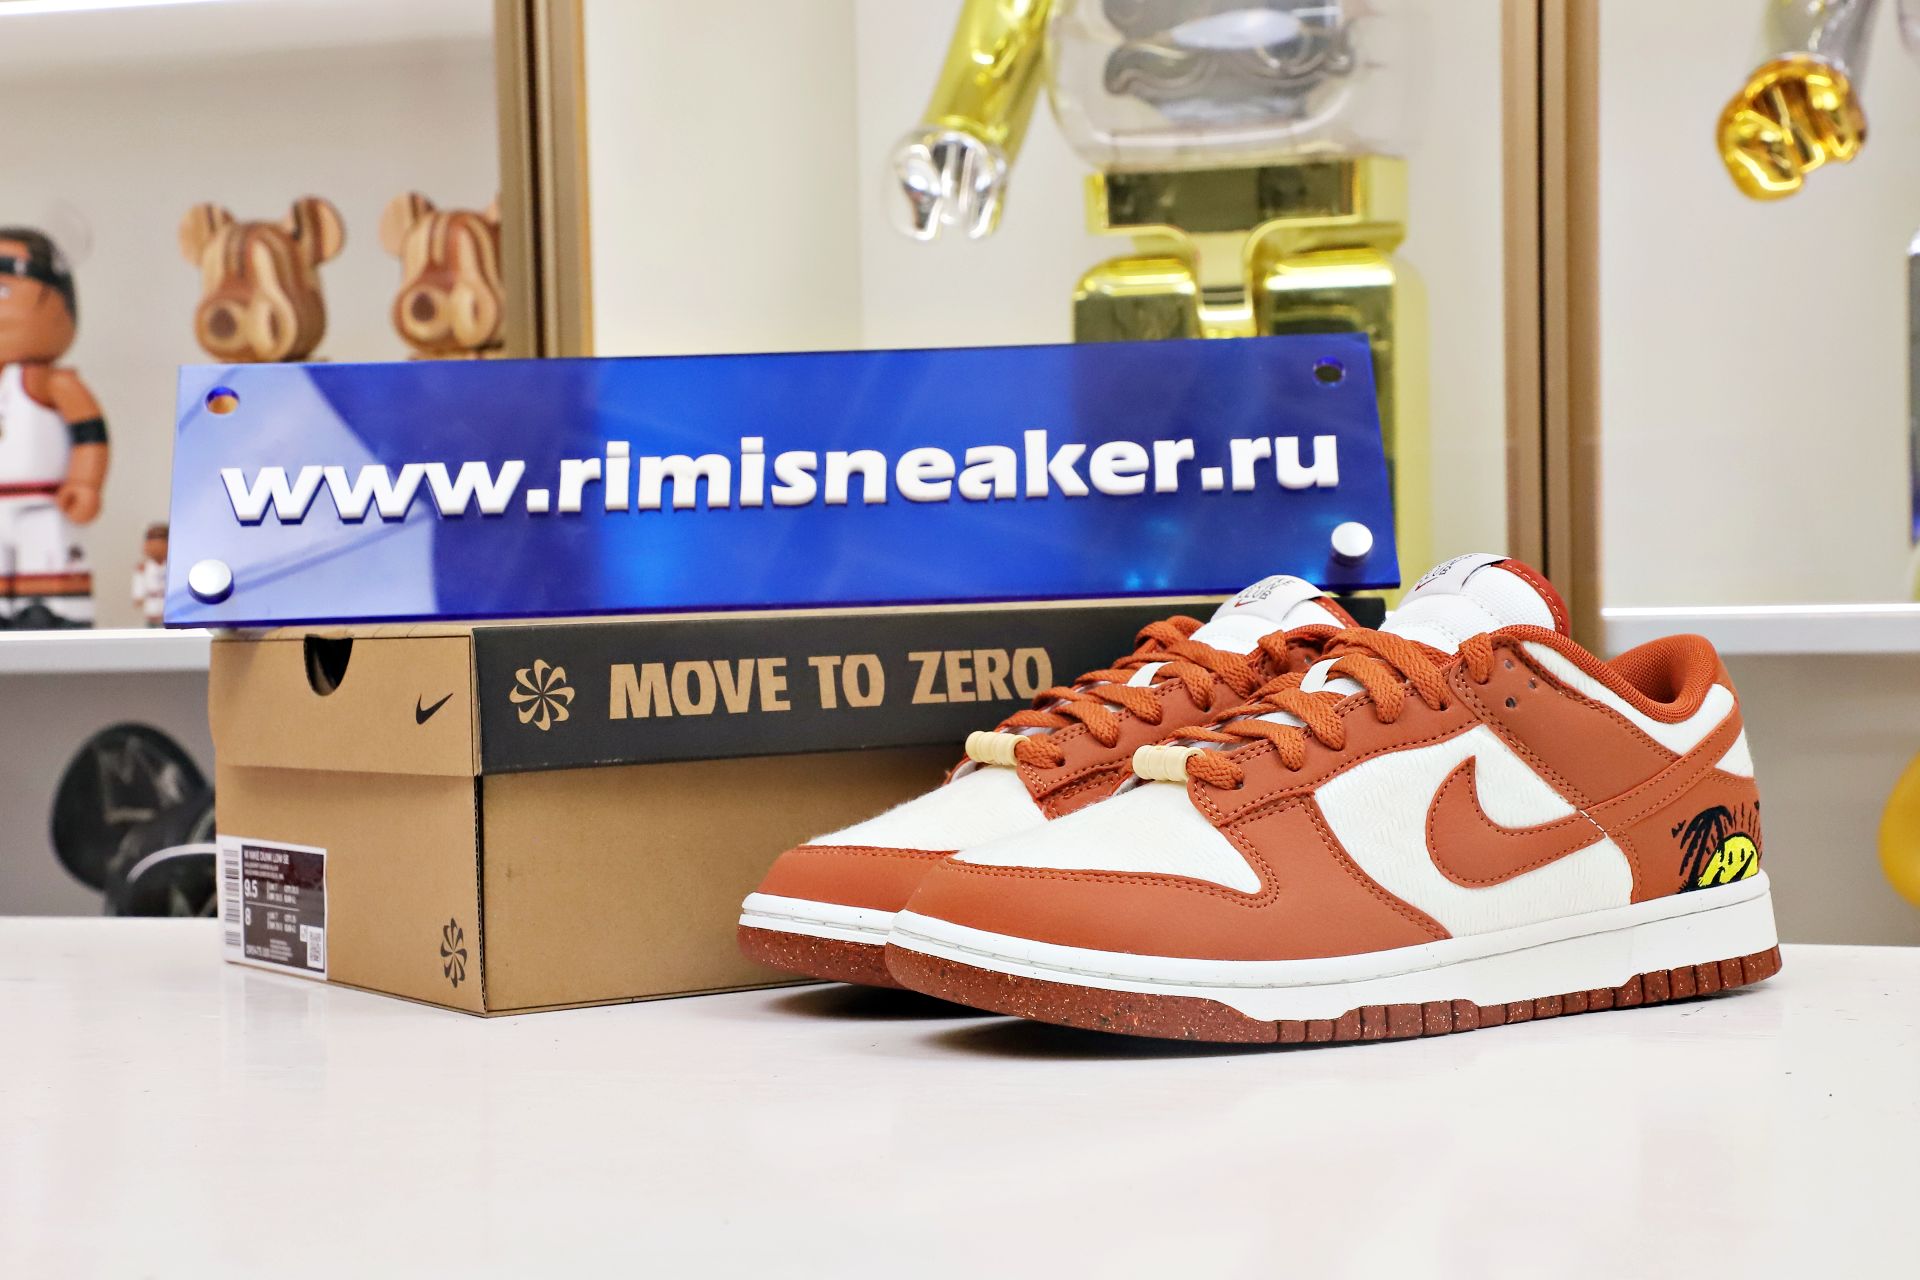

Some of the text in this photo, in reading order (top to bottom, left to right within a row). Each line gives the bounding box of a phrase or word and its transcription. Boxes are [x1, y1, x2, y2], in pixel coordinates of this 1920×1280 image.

[220, 429, 1340, 518] www.rimisneaker.ru
[609, 647, 1053, 720] MOVE TO ZERO
[244, 878, 258, 898] 9.5
[245, 907, 252, 926] 8
